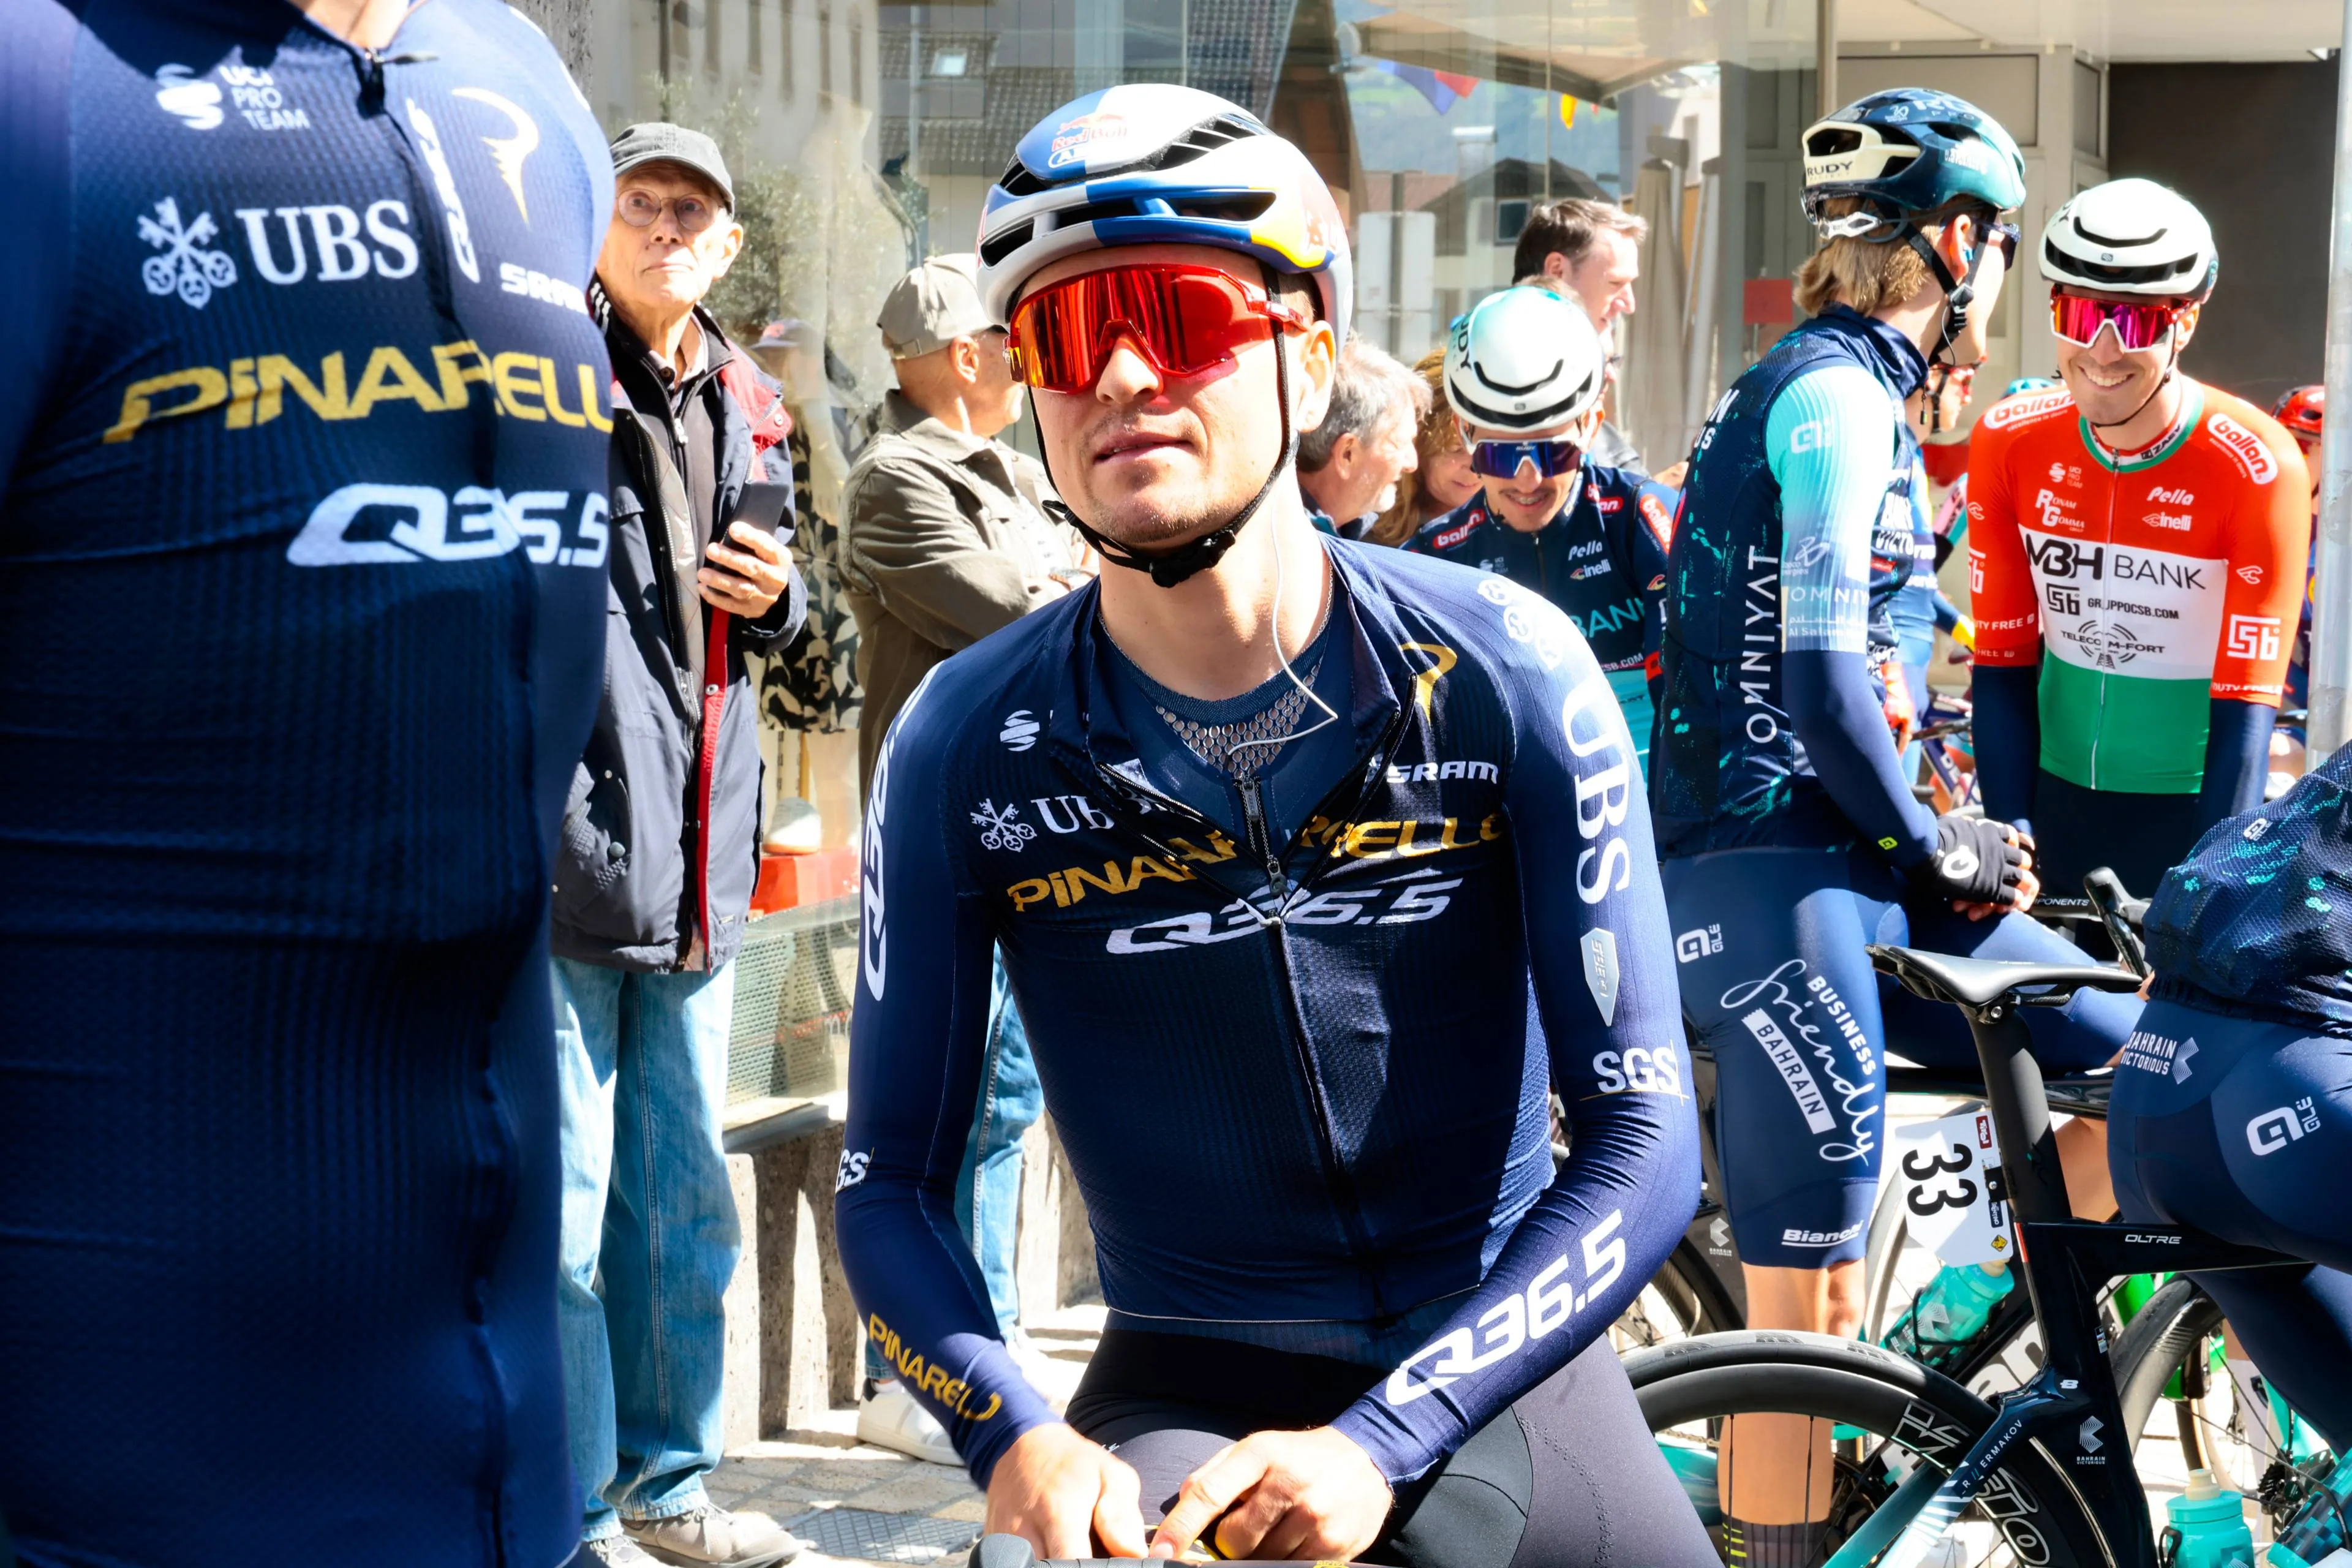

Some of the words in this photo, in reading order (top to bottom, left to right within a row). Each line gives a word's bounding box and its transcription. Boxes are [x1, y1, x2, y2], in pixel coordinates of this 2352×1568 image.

[231, 87, 283, 109] PRO
[241, 109, 311, 130] TEAM
[1052, 129, 1088, 152] Red
[1807, 160, 1853, 176] RUDY
[236, 200, 420, 284] UBS
[2068, 466, 2082, 474] UCI
[2214, 420, 2269, 475] ballan
[2146, 486, 2195, 506] Pella
[287, 483, 609, 567] Q36.5
[1569, 540, 1603, 560] Pella
[2026, 533, 2105, 581] MBH
[2114, 554, 2207, 590] BANK
[1740, 545, 1779, 744] OMNIYAT
[1992, 617, 2024, 631] FREE
[1386, 761, 1499, 785] SRAM
[1561, 666, 1630, 905] UBS
[1807, 975, 1877, 1076] BUSINESS
[2126, 1031, 2178, 1060] BAHRAIN
[1593, 1047, 1679, 1094] SGS
[1756, 1022, 1826, 1118] BAHRAIN
[2120, 1050, 2171, 1076] VICTORIOUS
[835, 1148, 870, 1193] GS
[1902, 1143, 1978, 1216] 33
[2125, 1234, 2182, 1245] OLTRE
[1385, 1208, 1627, 1406] Q36.5
[1980, 1419, 2023, 1468] ERMAKOV
